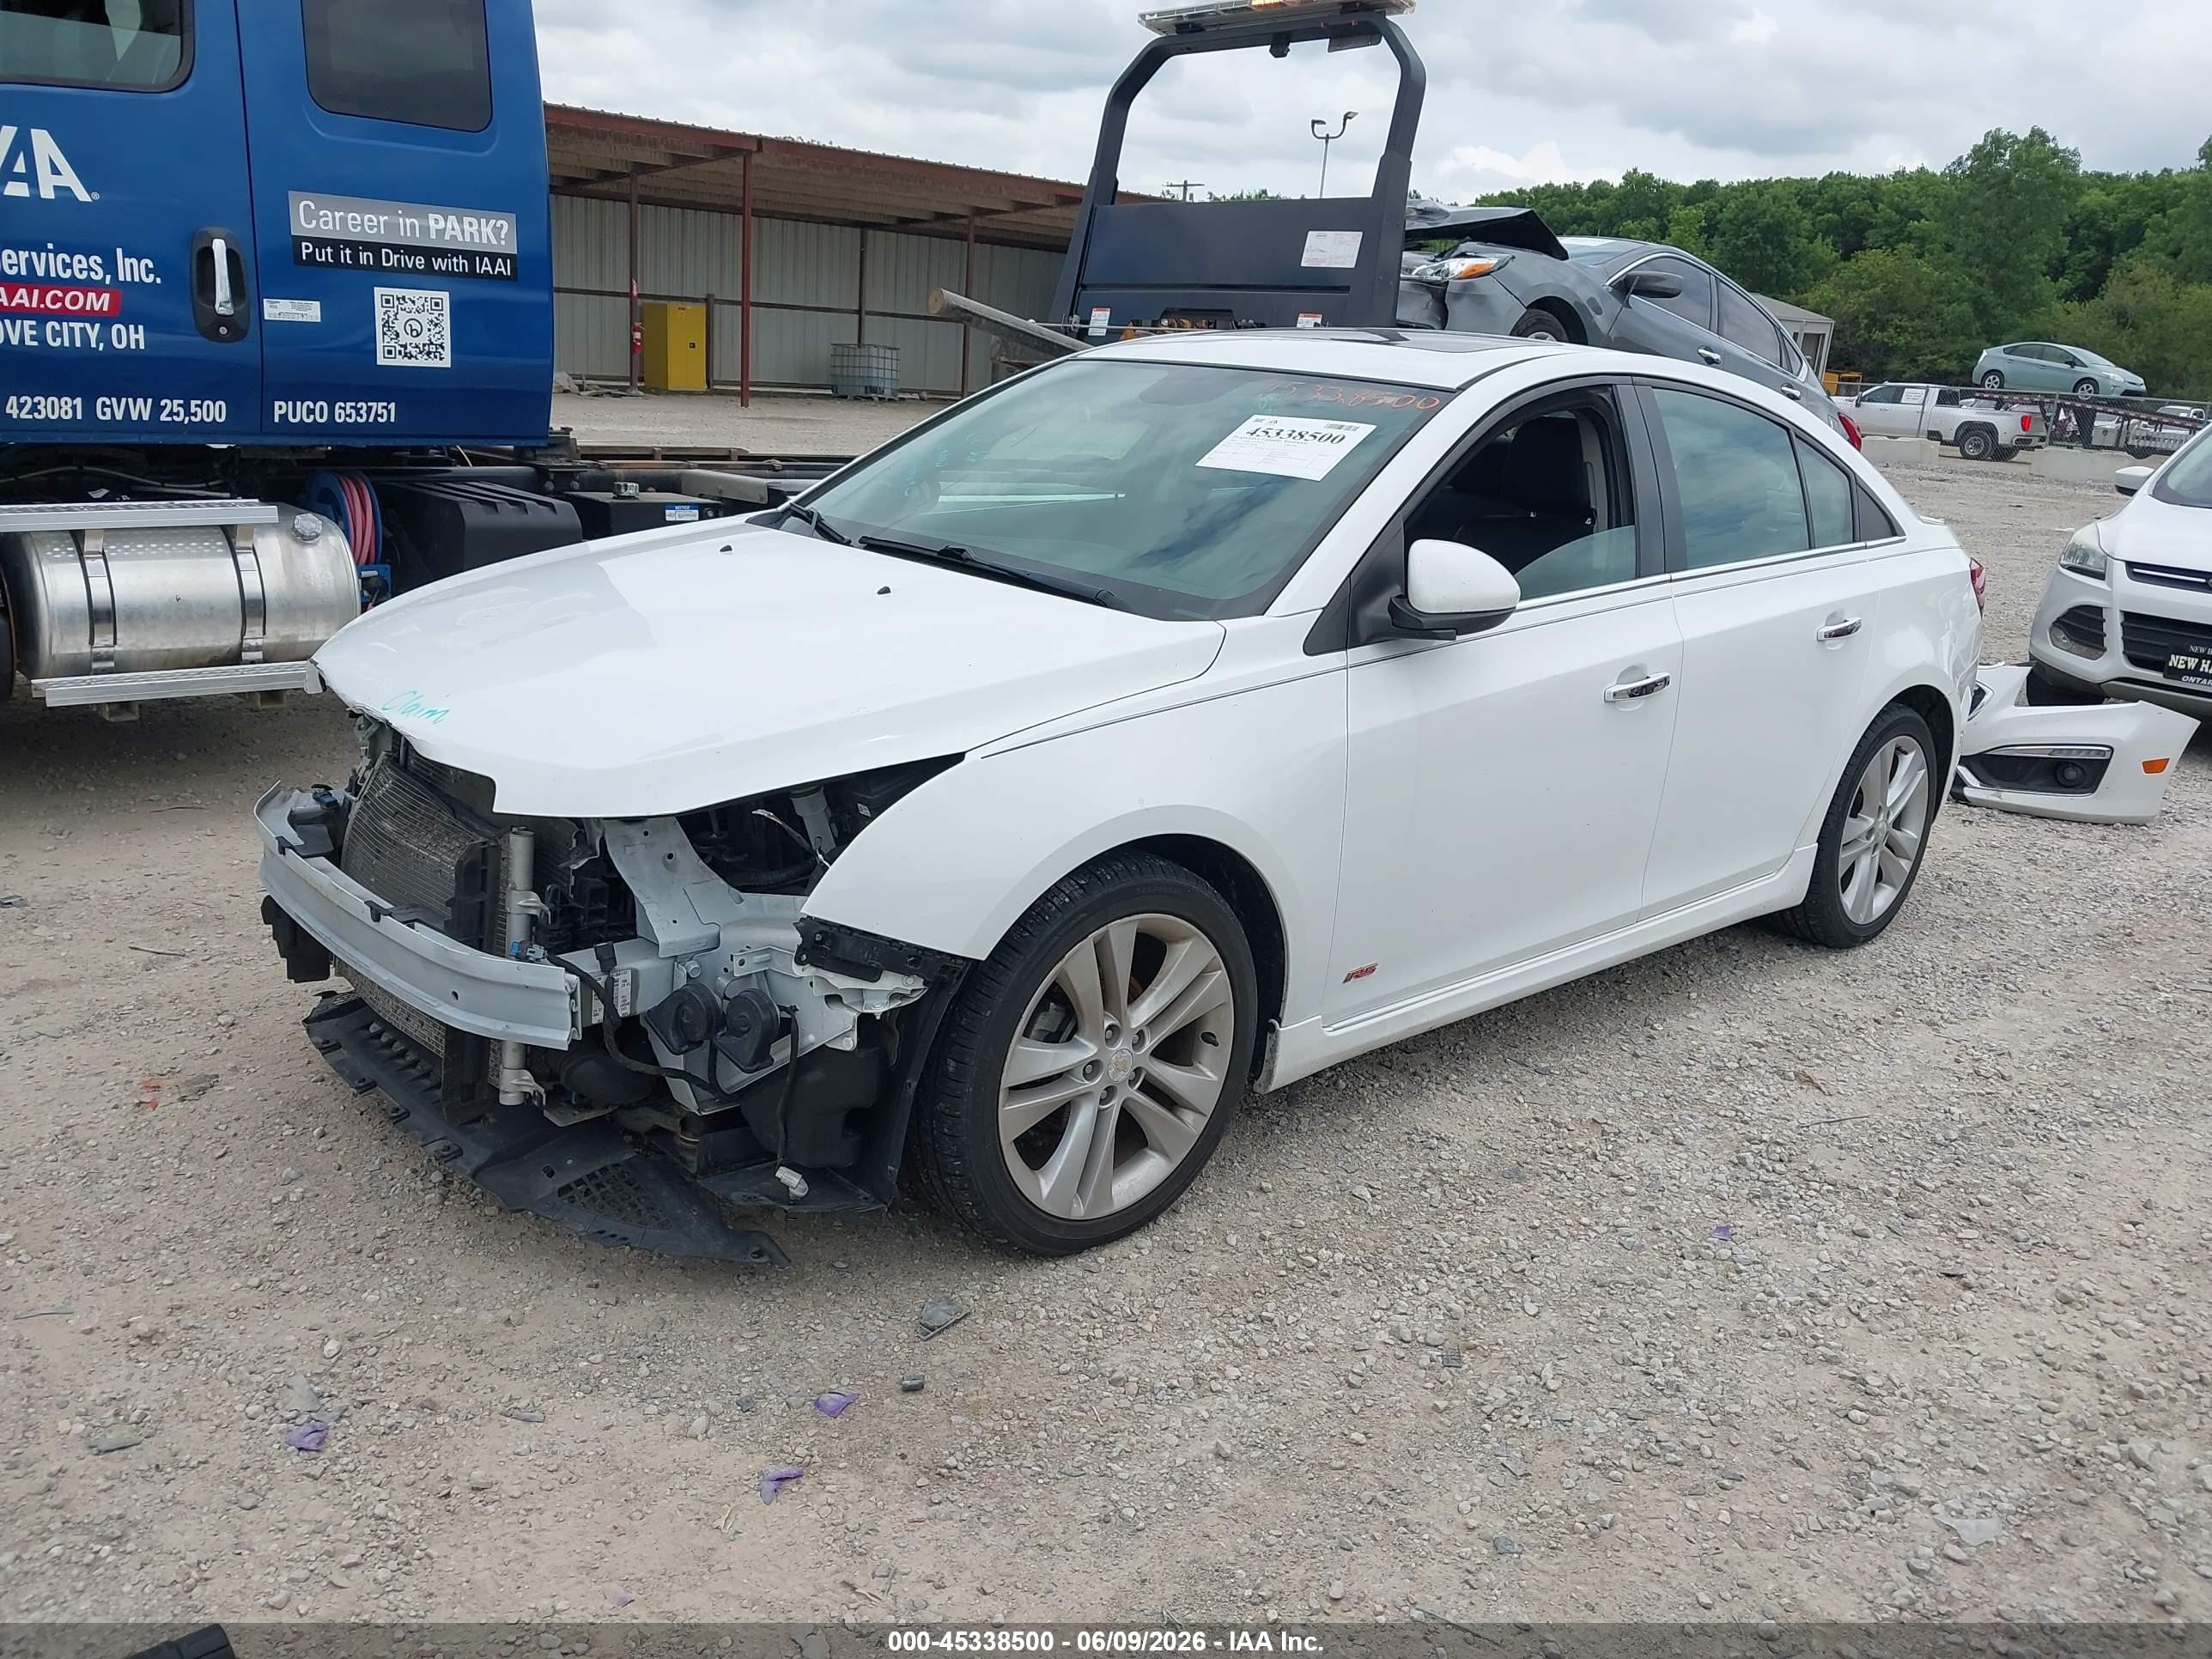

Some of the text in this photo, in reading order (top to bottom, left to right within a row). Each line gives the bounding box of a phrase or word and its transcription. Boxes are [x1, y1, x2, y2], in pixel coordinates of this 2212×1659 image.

[299, 200, 509, 246] Career in PARK?
[0, 243, 161, 285] ervices, Inc.
[301, 241, 511, 276] Put it in Drive with IAAI
[46, 320, 104, 351] CITY,
[111, 323, 145, 350] OH
[5, 395, 227, 424] 423081 GVW 25,500
[273, 400, 396, 423] PUCO 653751
[1245, 427, 1346, 445] 45338500
[2168, 653, 2199, 670] NEW
